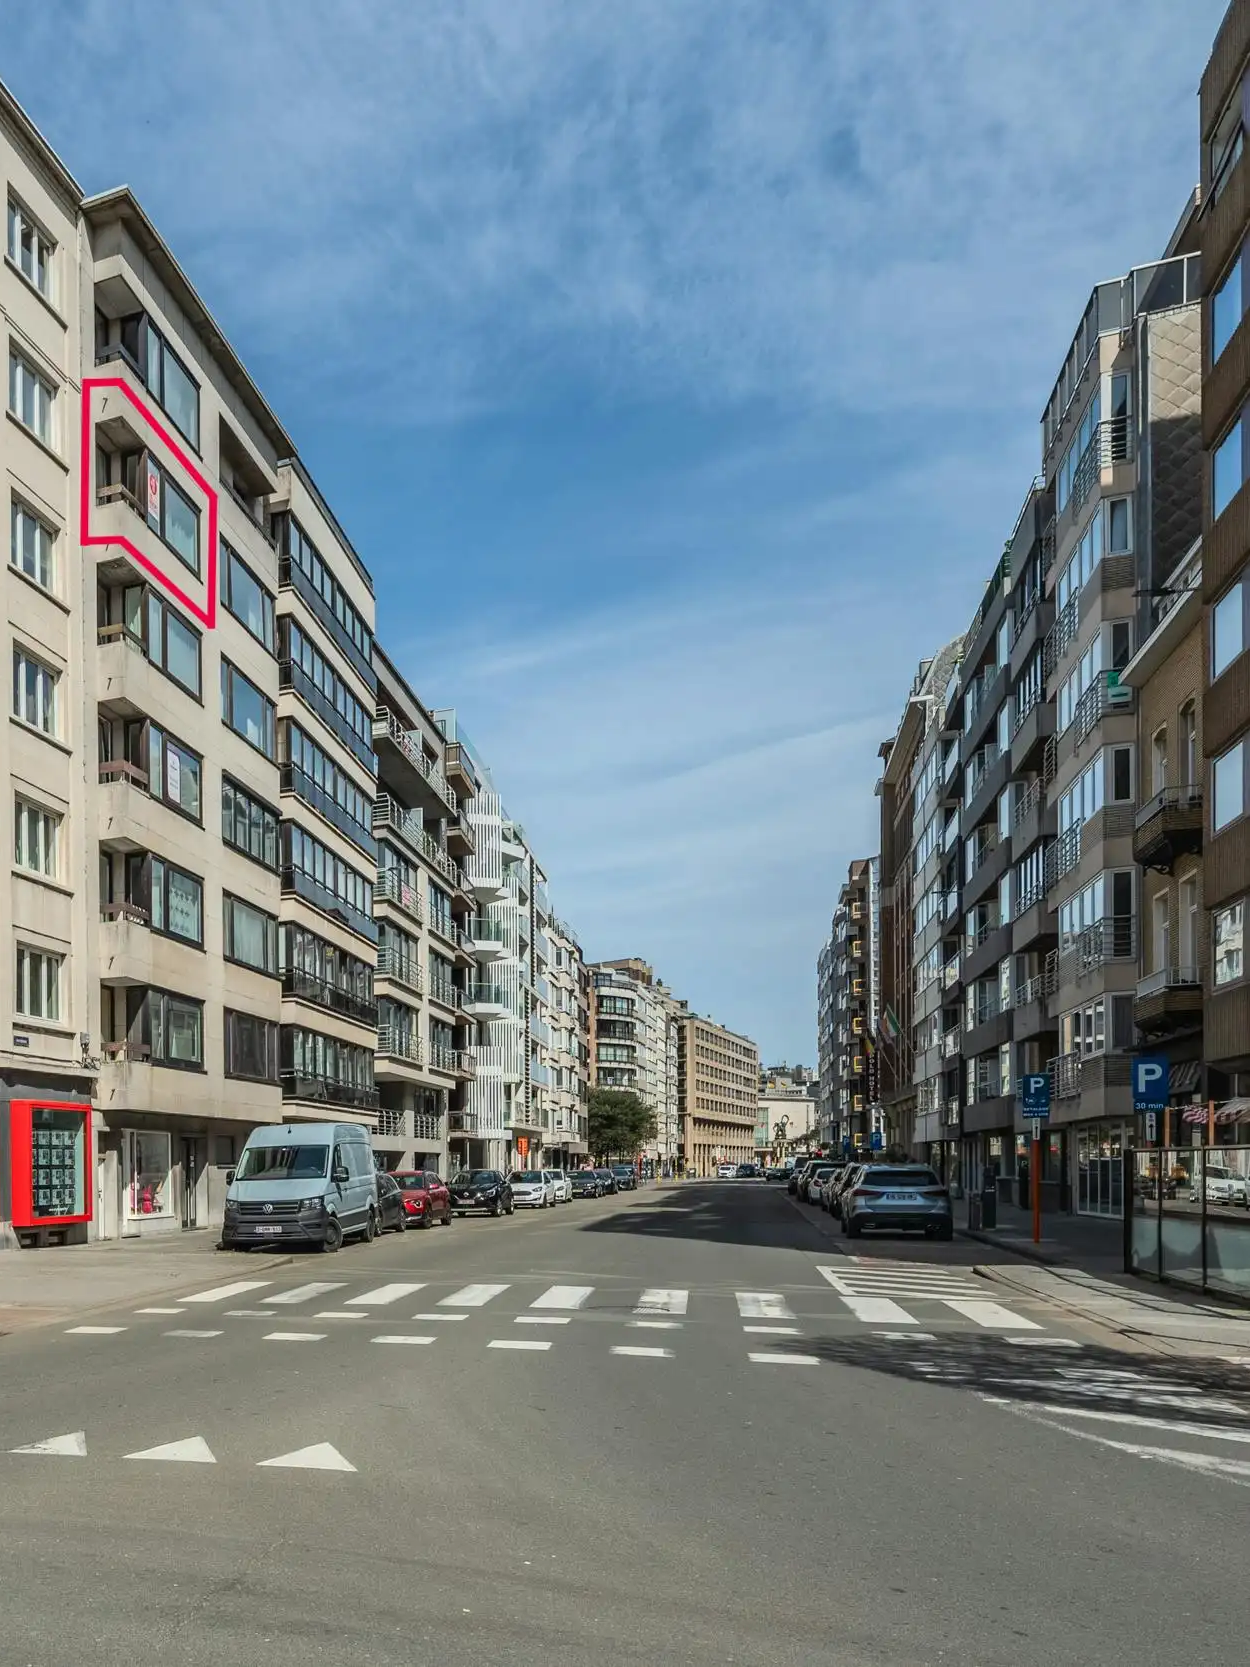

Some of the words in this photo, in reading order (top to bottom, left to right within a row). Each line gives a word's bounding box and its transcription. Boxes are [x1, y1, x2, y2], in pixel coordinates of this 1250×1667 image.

[1030, 1077, 1045, 1094] P
[1137, 1063, 1163, 1093] P
[1135, 1102, 1146, 1110] 30
